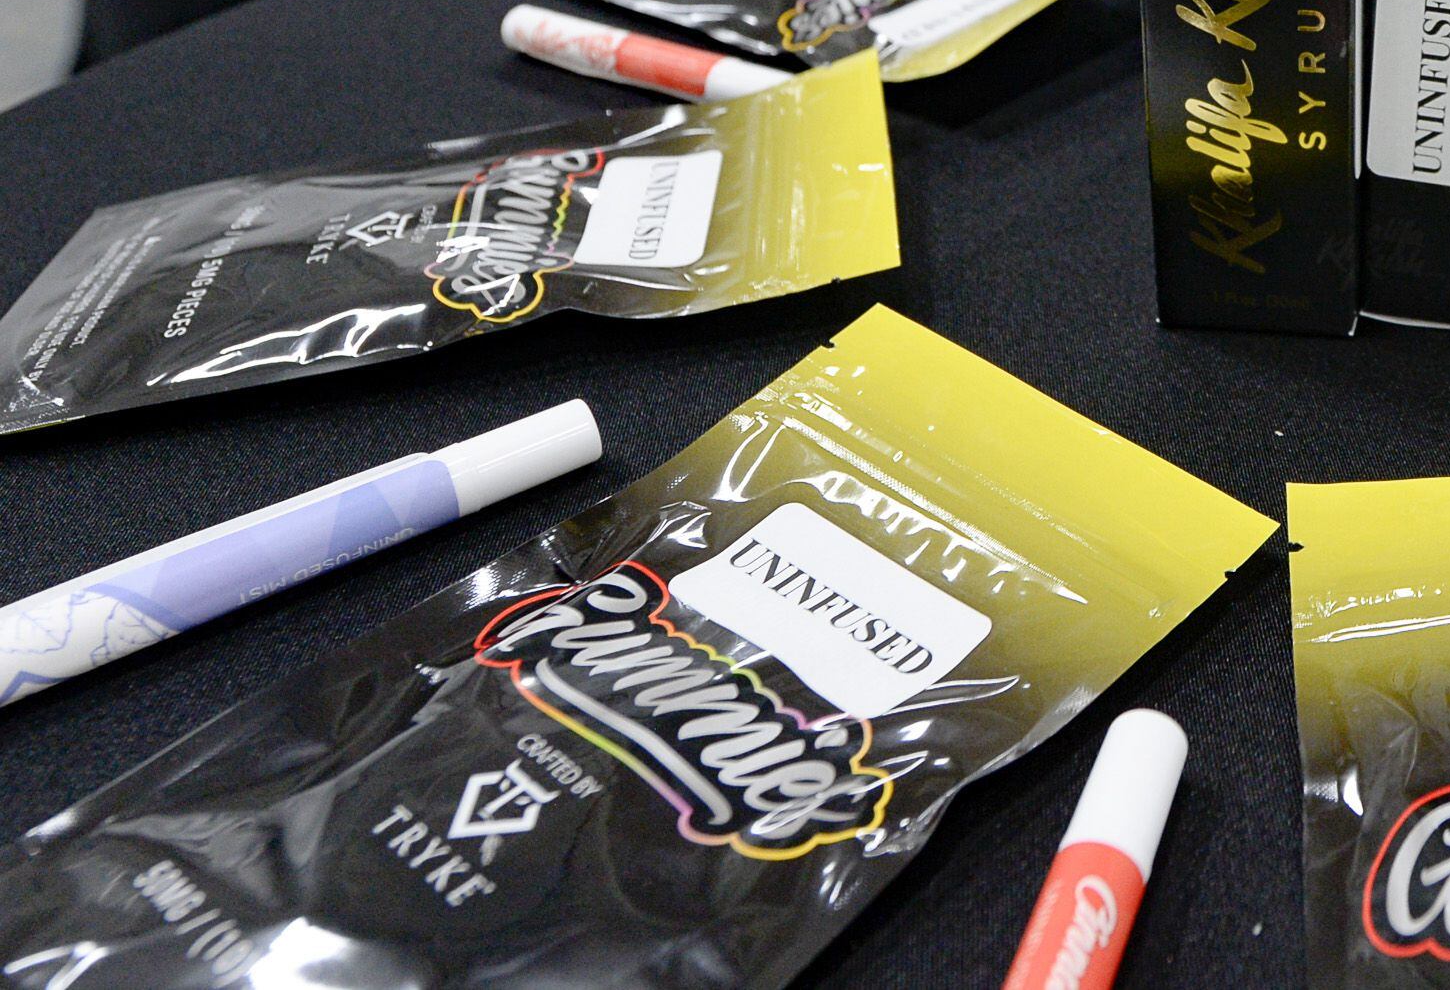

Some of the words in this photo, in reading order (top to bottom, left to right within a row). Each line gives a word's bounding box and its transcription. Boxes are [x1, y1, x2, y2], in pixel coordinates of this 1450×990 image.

[628, 160, 680, 261] UNINFUSED
[163, 287, 208, 340] PIECES
[294, 527, 416, 582] UNINFUSED
[728, 537, 936, 679] UNINFUSED
[497, 572, 870, 840] Gummies
[516, 733, 583, 786] CRAFTED
[570, 775, 604, 800] BY
